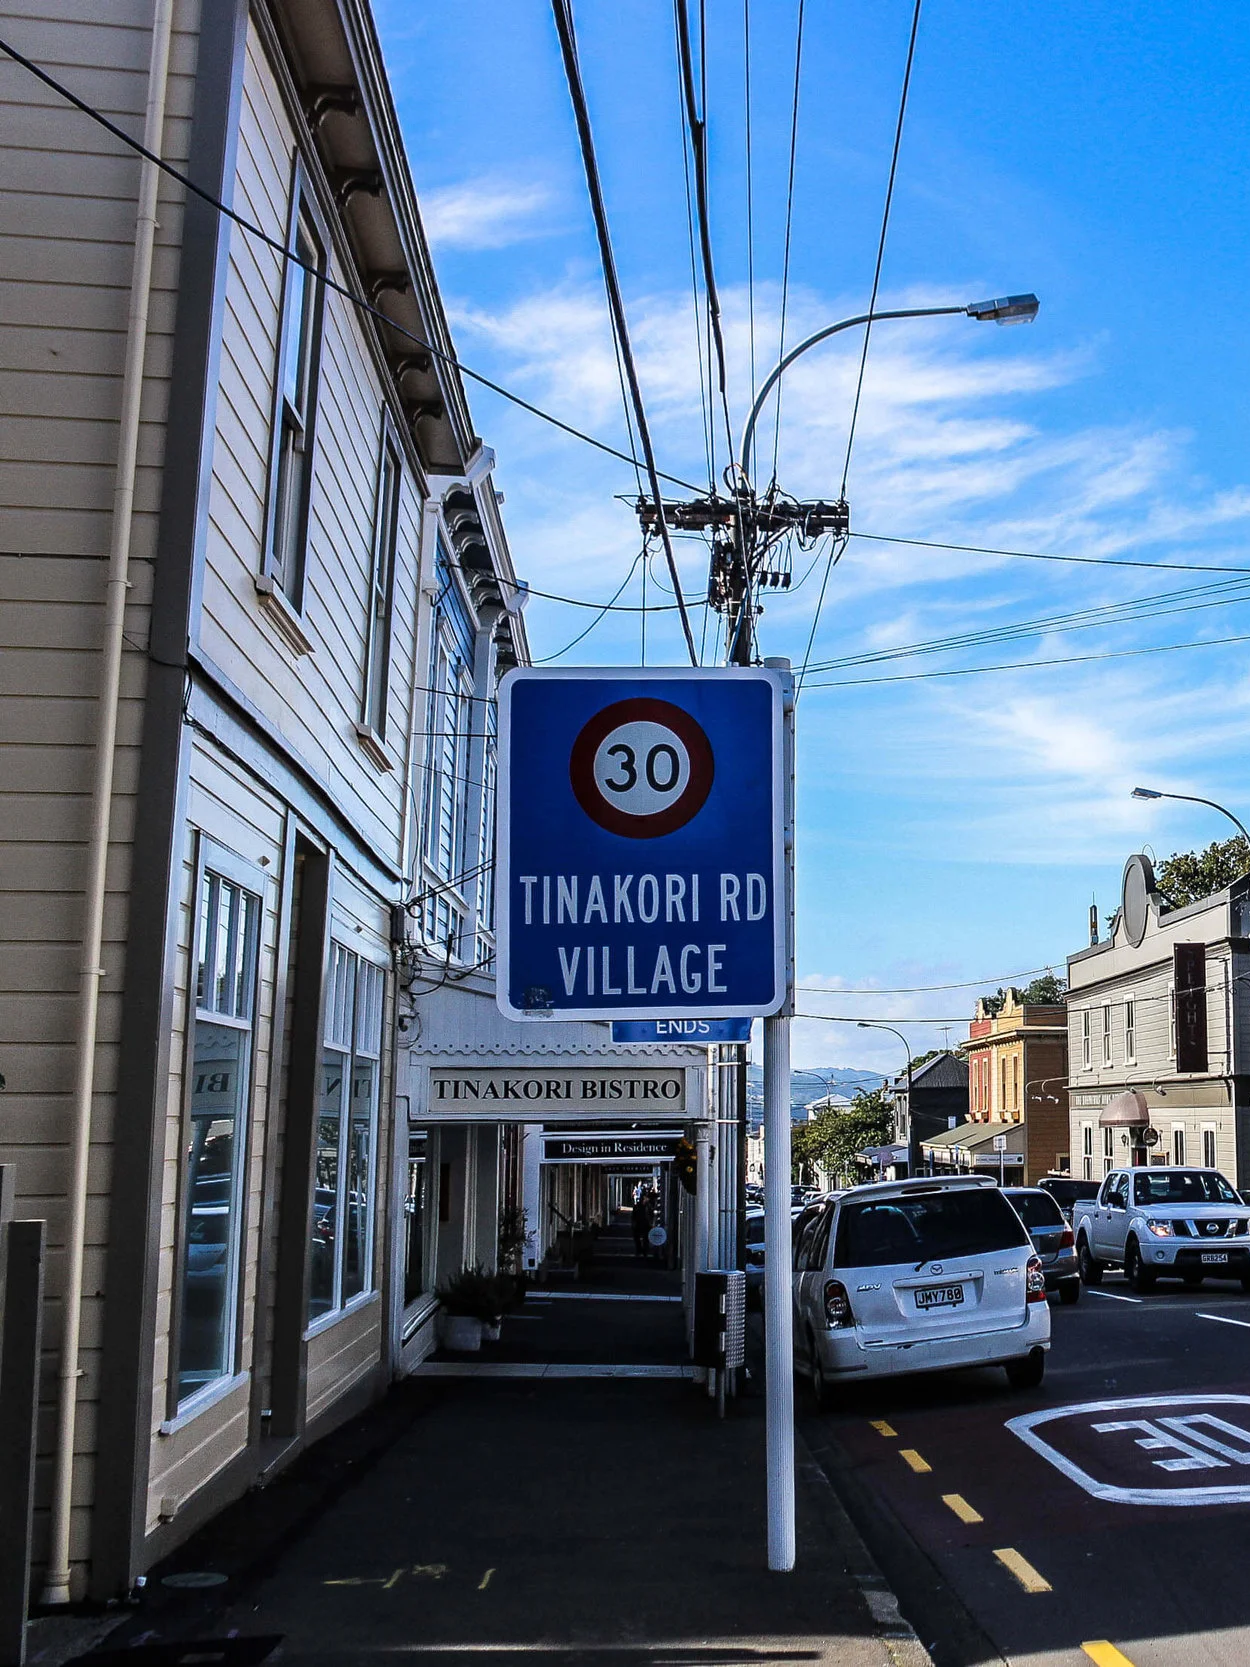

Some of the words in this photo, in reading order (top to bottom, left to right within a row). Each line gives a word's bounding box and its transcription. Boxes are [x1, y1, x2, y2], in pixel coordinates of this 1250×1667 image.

[604, 743, 680, 793] 30
[519, 873, 699, 925] TINAKORI
[720, 873, 767, 921] RD
[558, 944, 728, 996] VILLAGE
[656, 1020, 711, 1035] ENDS
[433, 1080, 572, 1101] TINAKORI
[580, 1079, 681, 1100] BISTRO
[562, 1143, 598, 1155] Design
[601, 1143, 611, 1152] in
[614, 1142, 667, 1153] Residence
[918, 1289, 962, 1304] JMY780
